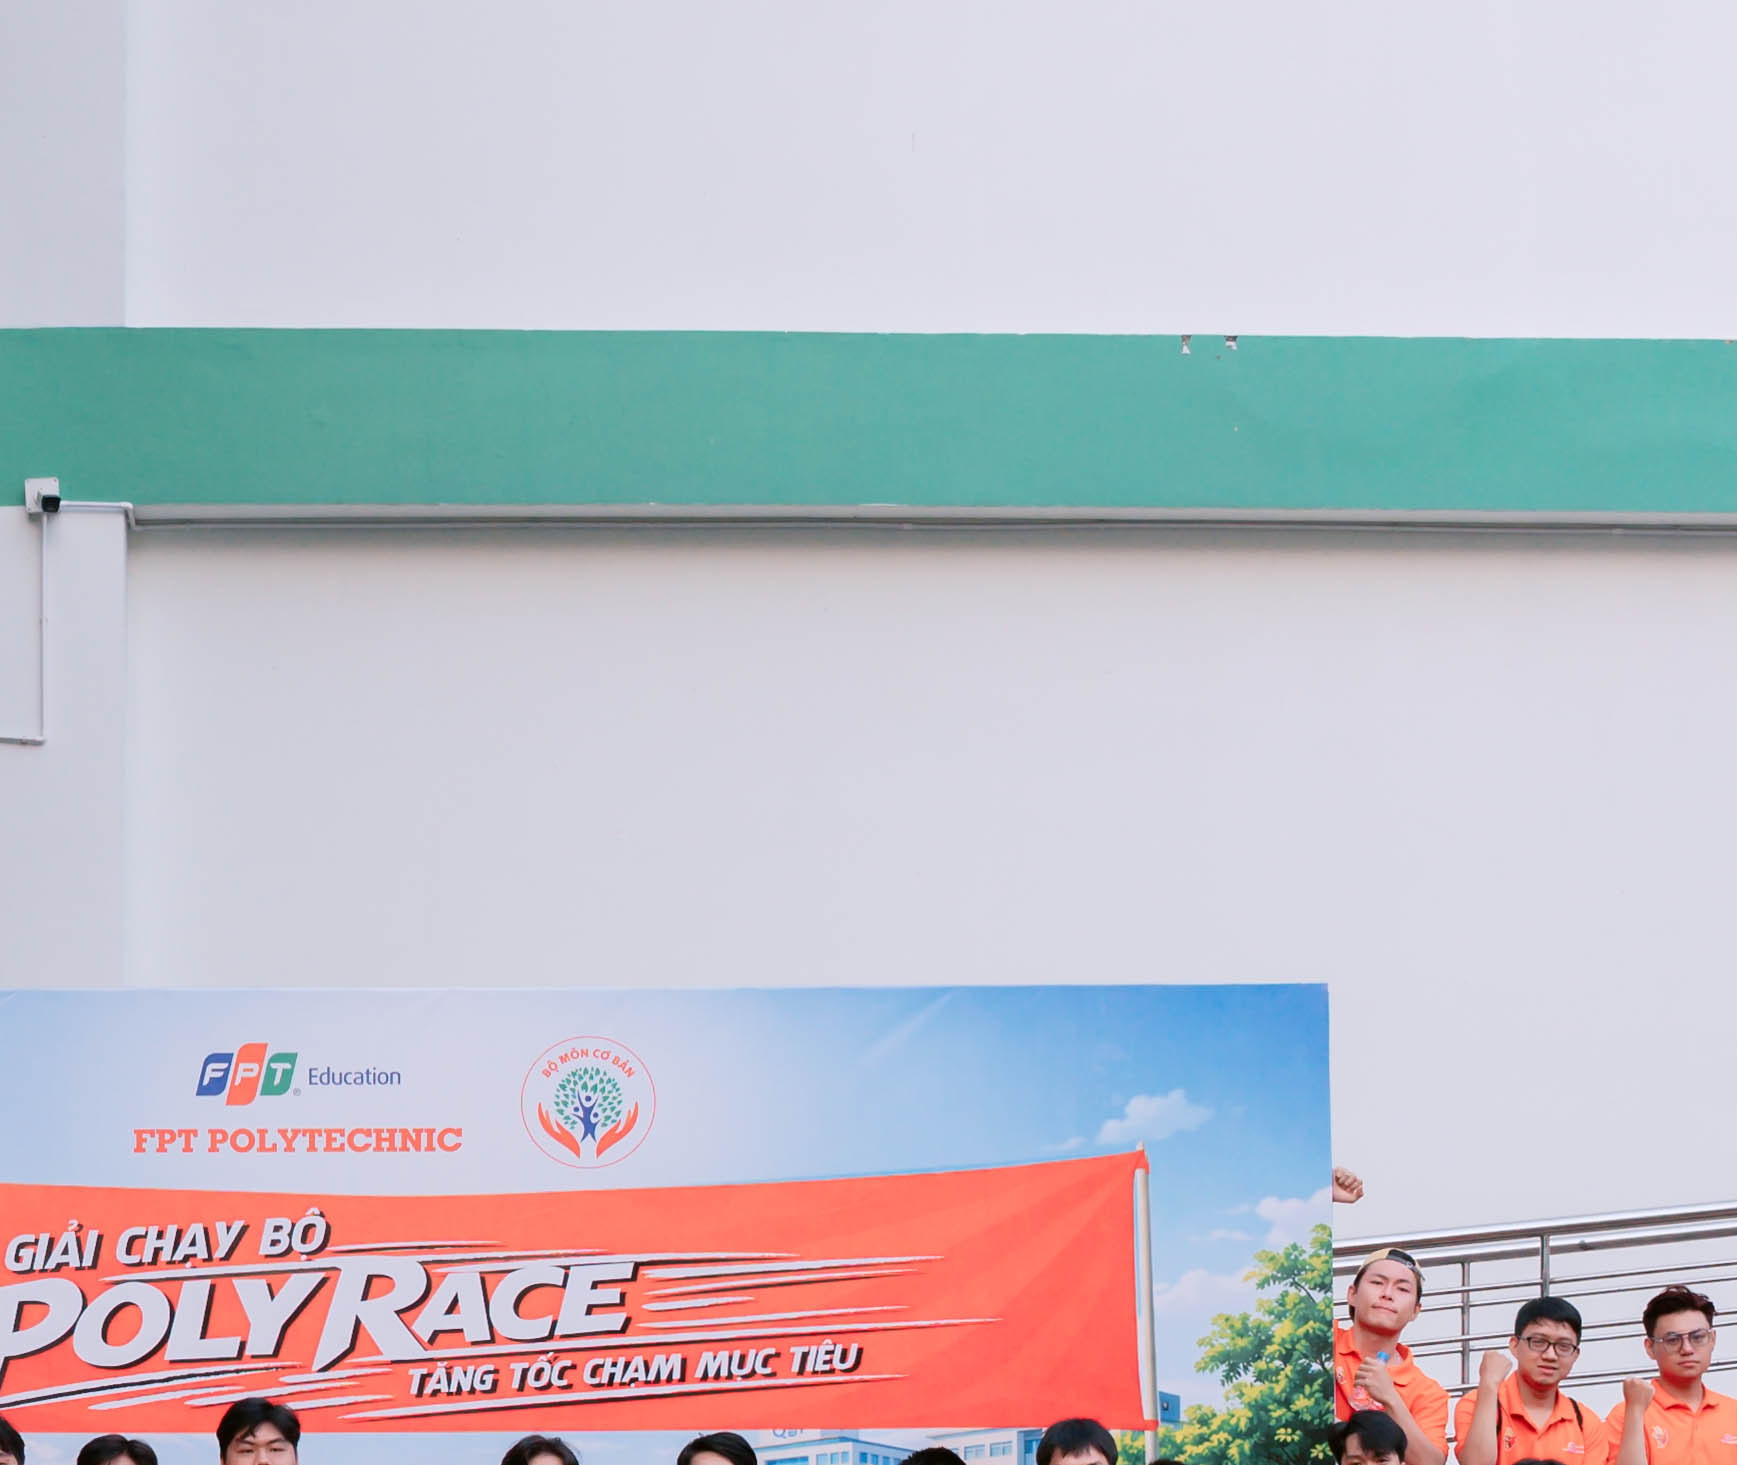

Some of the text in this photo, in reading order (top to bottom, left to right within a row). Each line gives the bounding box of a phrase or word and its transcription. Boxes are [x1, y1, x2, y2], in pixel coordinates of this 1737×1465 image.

[308, 1066, 401, 1086] Education
[133, 1127, 463, 1153] FPT POLYTECHNIC
[4, 1207, 330, 1273] GIẢI CHẠY BỘ
[408, 1340, 864, 1398] TĂNG TỐC CHẠM MỤC TIÊU
